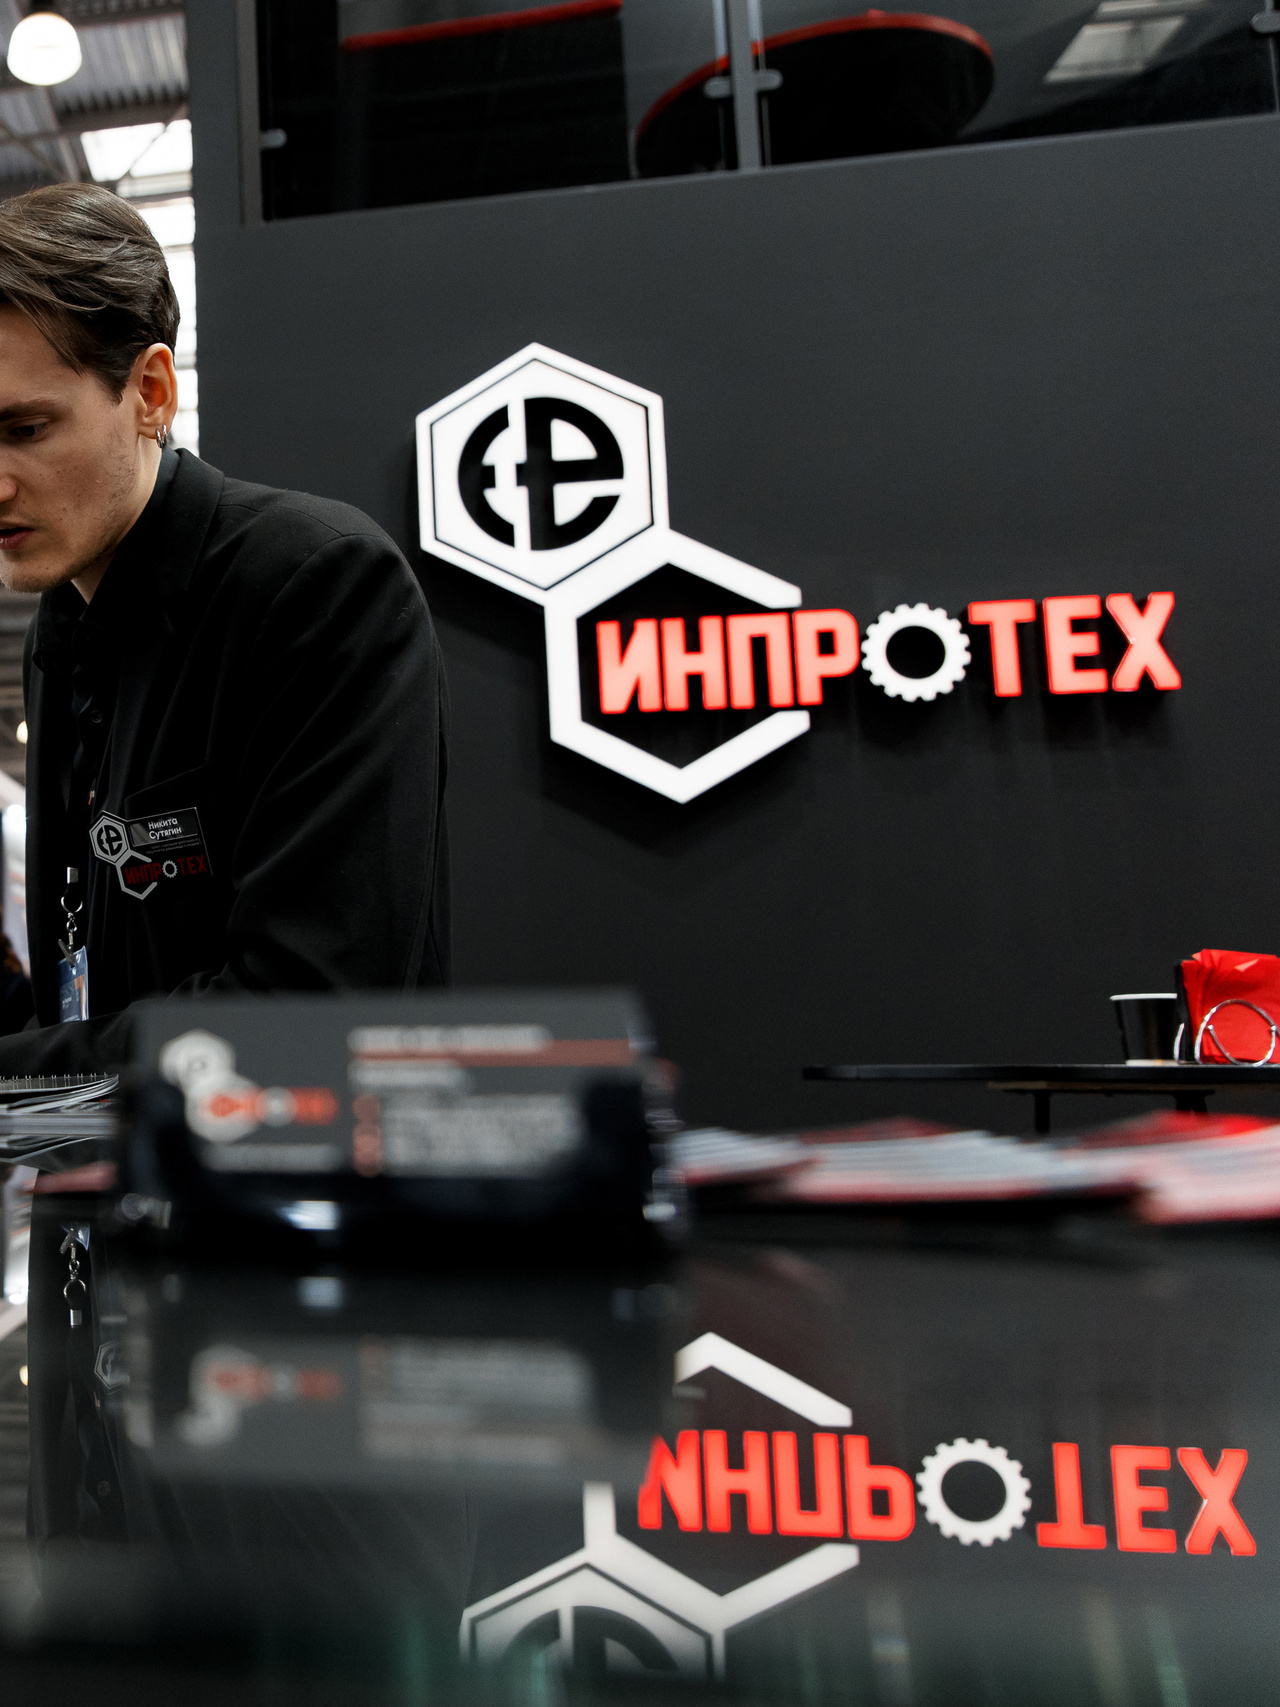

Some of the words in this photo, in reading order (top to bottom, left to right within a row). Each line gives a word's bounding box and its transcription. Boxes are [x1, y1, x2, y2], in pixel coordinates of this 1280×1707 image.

[596, 591, 1183, 715] ИНПРОТЕХ
[148, 817, 178, 831] Никита
[148, 826, 182, 841] Сутягин
[124, 854, 207, 886] ИНПРОТЕХ
